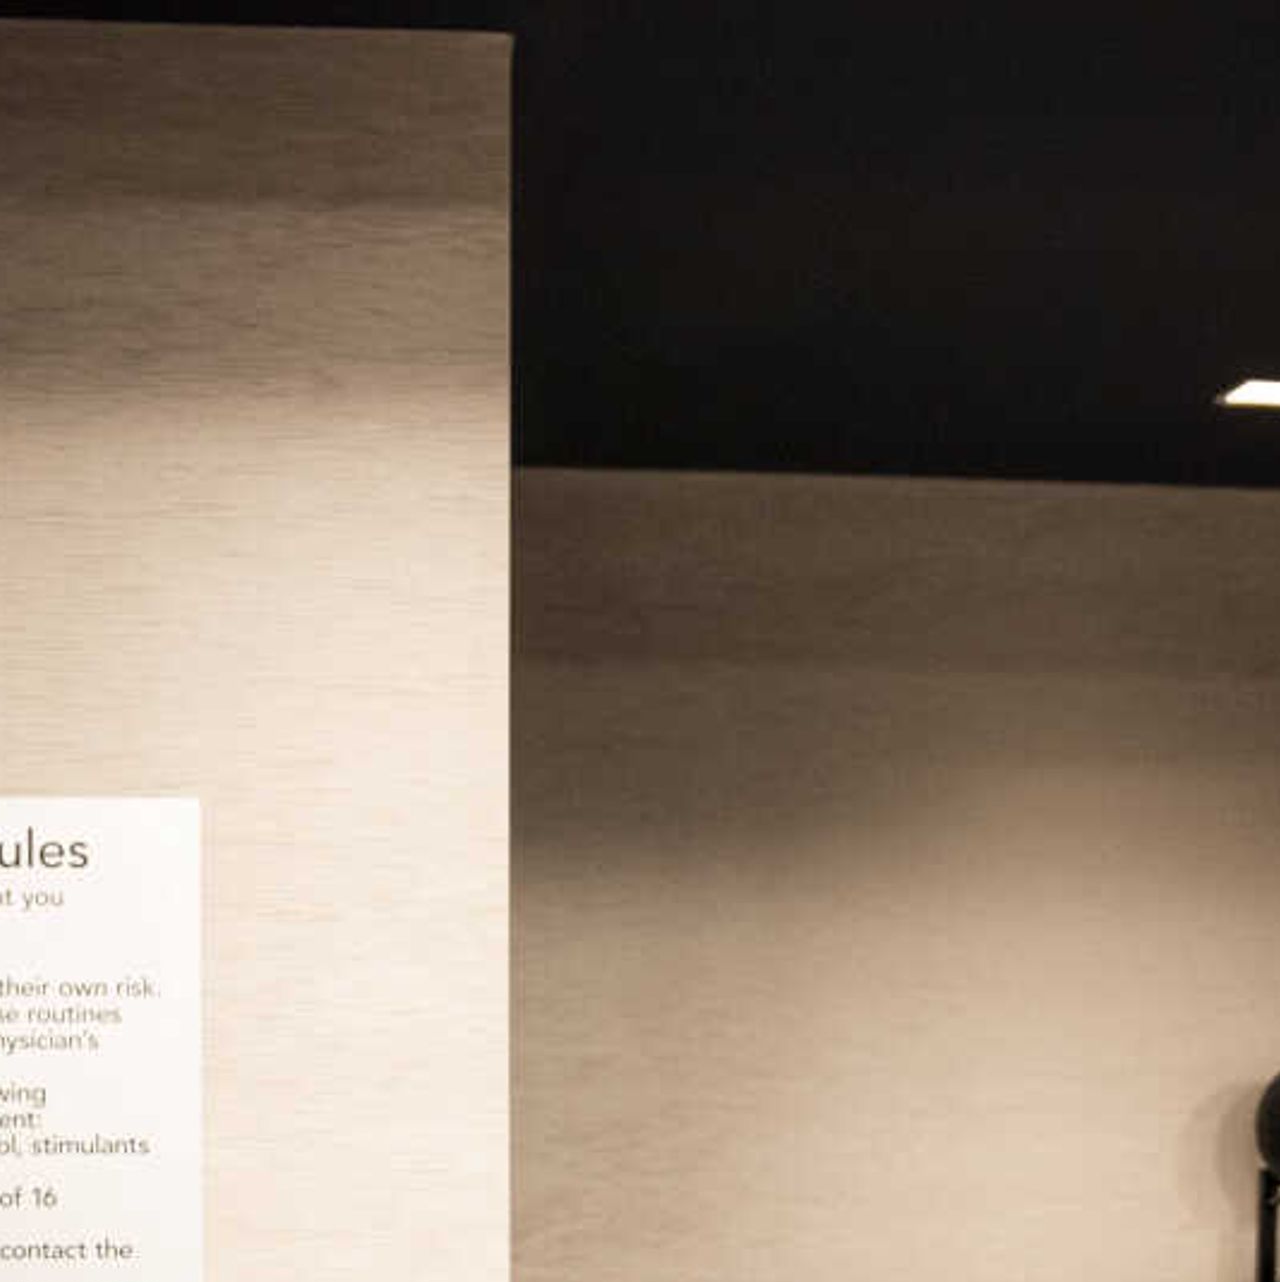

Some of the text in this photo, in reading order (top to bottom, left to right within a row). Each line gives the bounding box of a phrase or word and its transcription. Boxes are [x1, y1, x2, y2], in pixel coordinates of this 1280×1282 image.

[21, 890, 64, 911] you
[58, 981, 108, 998] own
[116, 974, 161, 998] risk.
[27, 1001, 122, 1024] routines
[32, 1132, 151, 1155] stimulants
[32, 1185, 58, 1208] 16
[0, 1237, 87, 1261] contact
[94, 1237, 134, 1261] the
